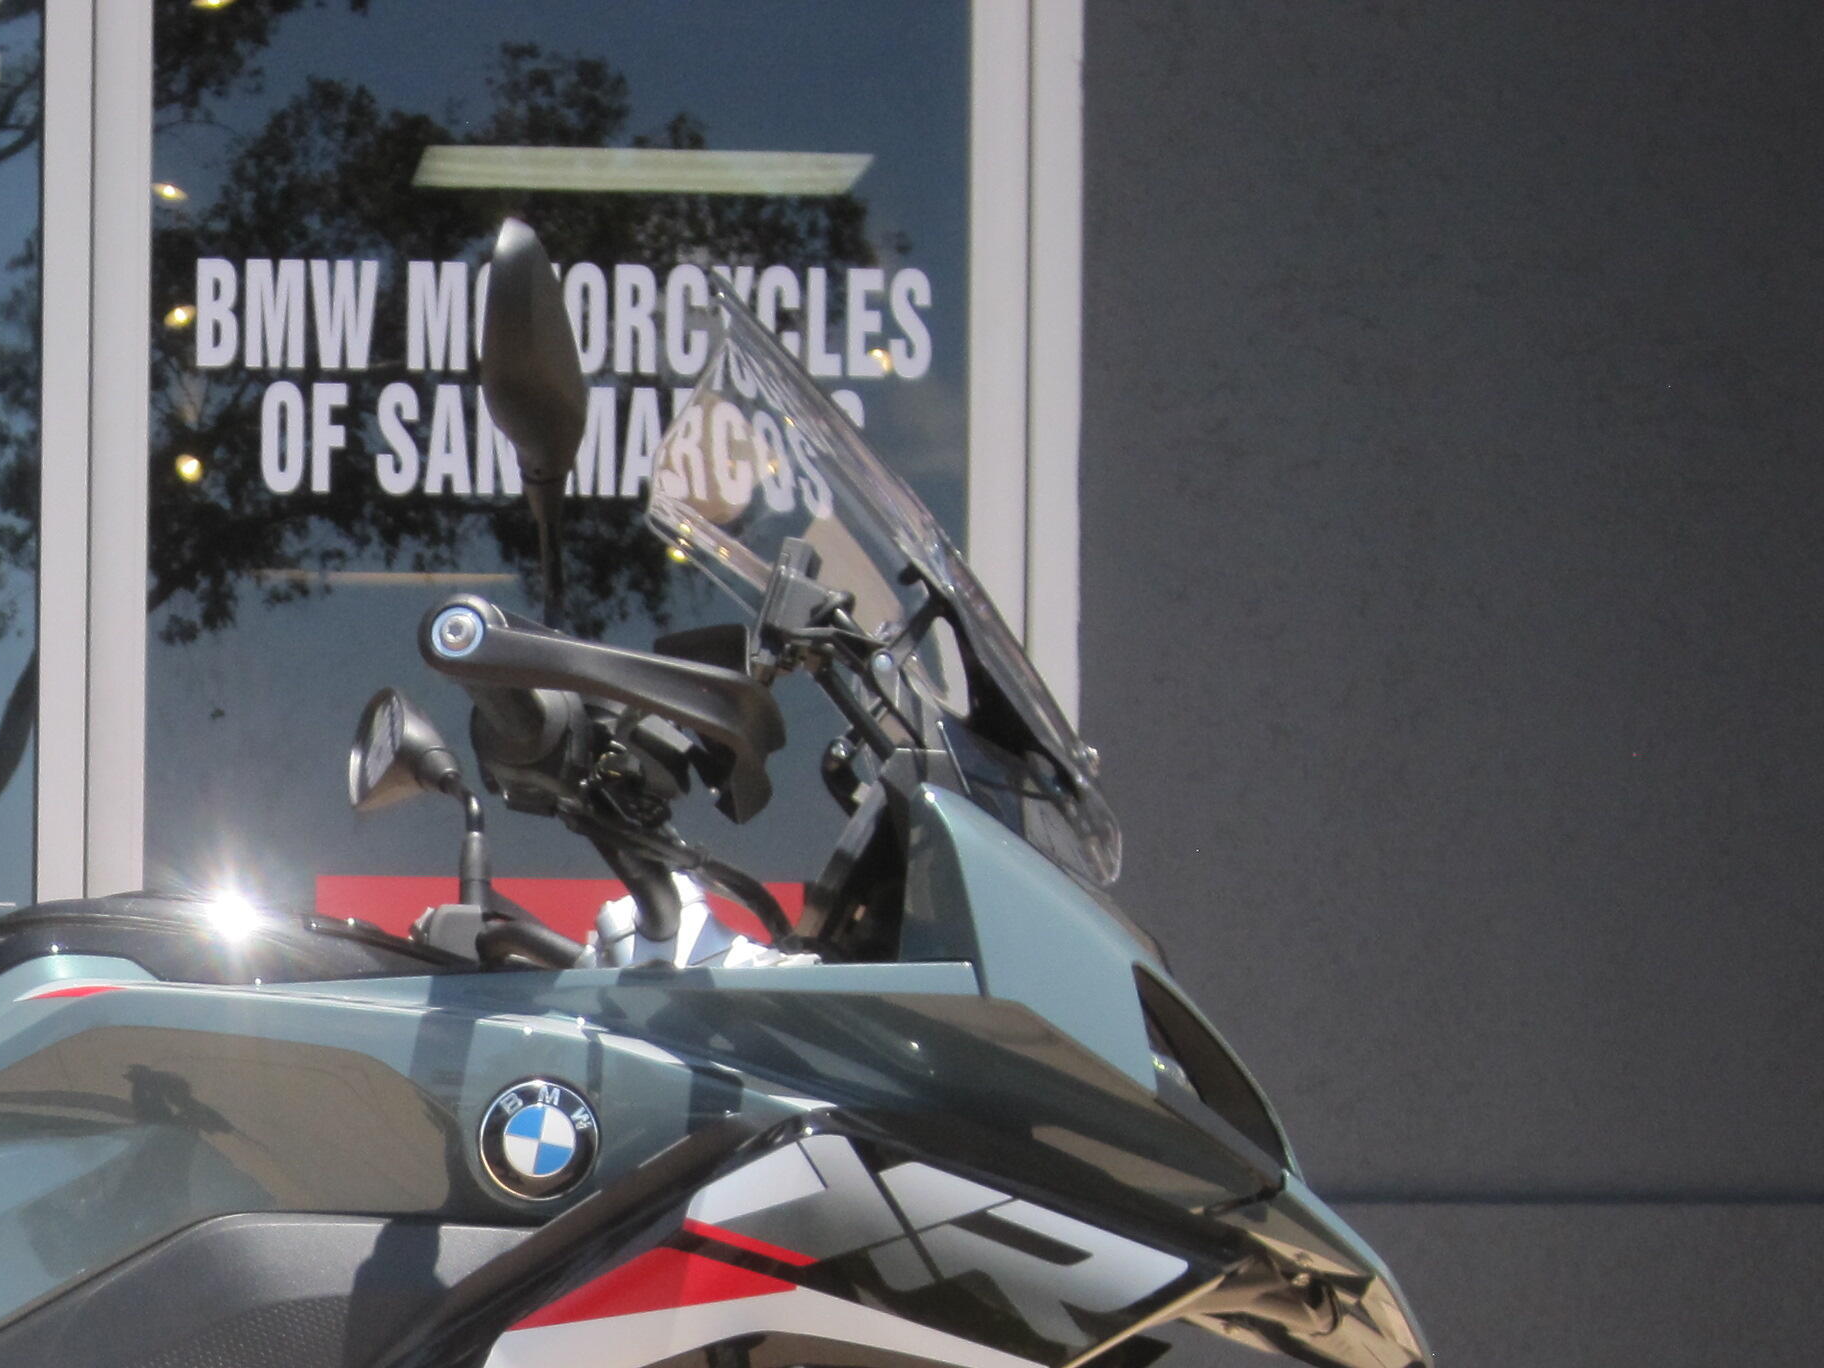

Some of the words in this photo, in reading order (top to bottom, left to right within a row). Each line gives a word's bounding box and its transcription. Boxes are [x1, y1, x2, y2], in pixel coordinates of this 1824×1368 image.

[196, 258, 378, 370] BMW
[407, 260, 932, 380] MORCYCLES
[260, 381, 346, 494] OF
[500, 1085, 592, 1130] BMW
